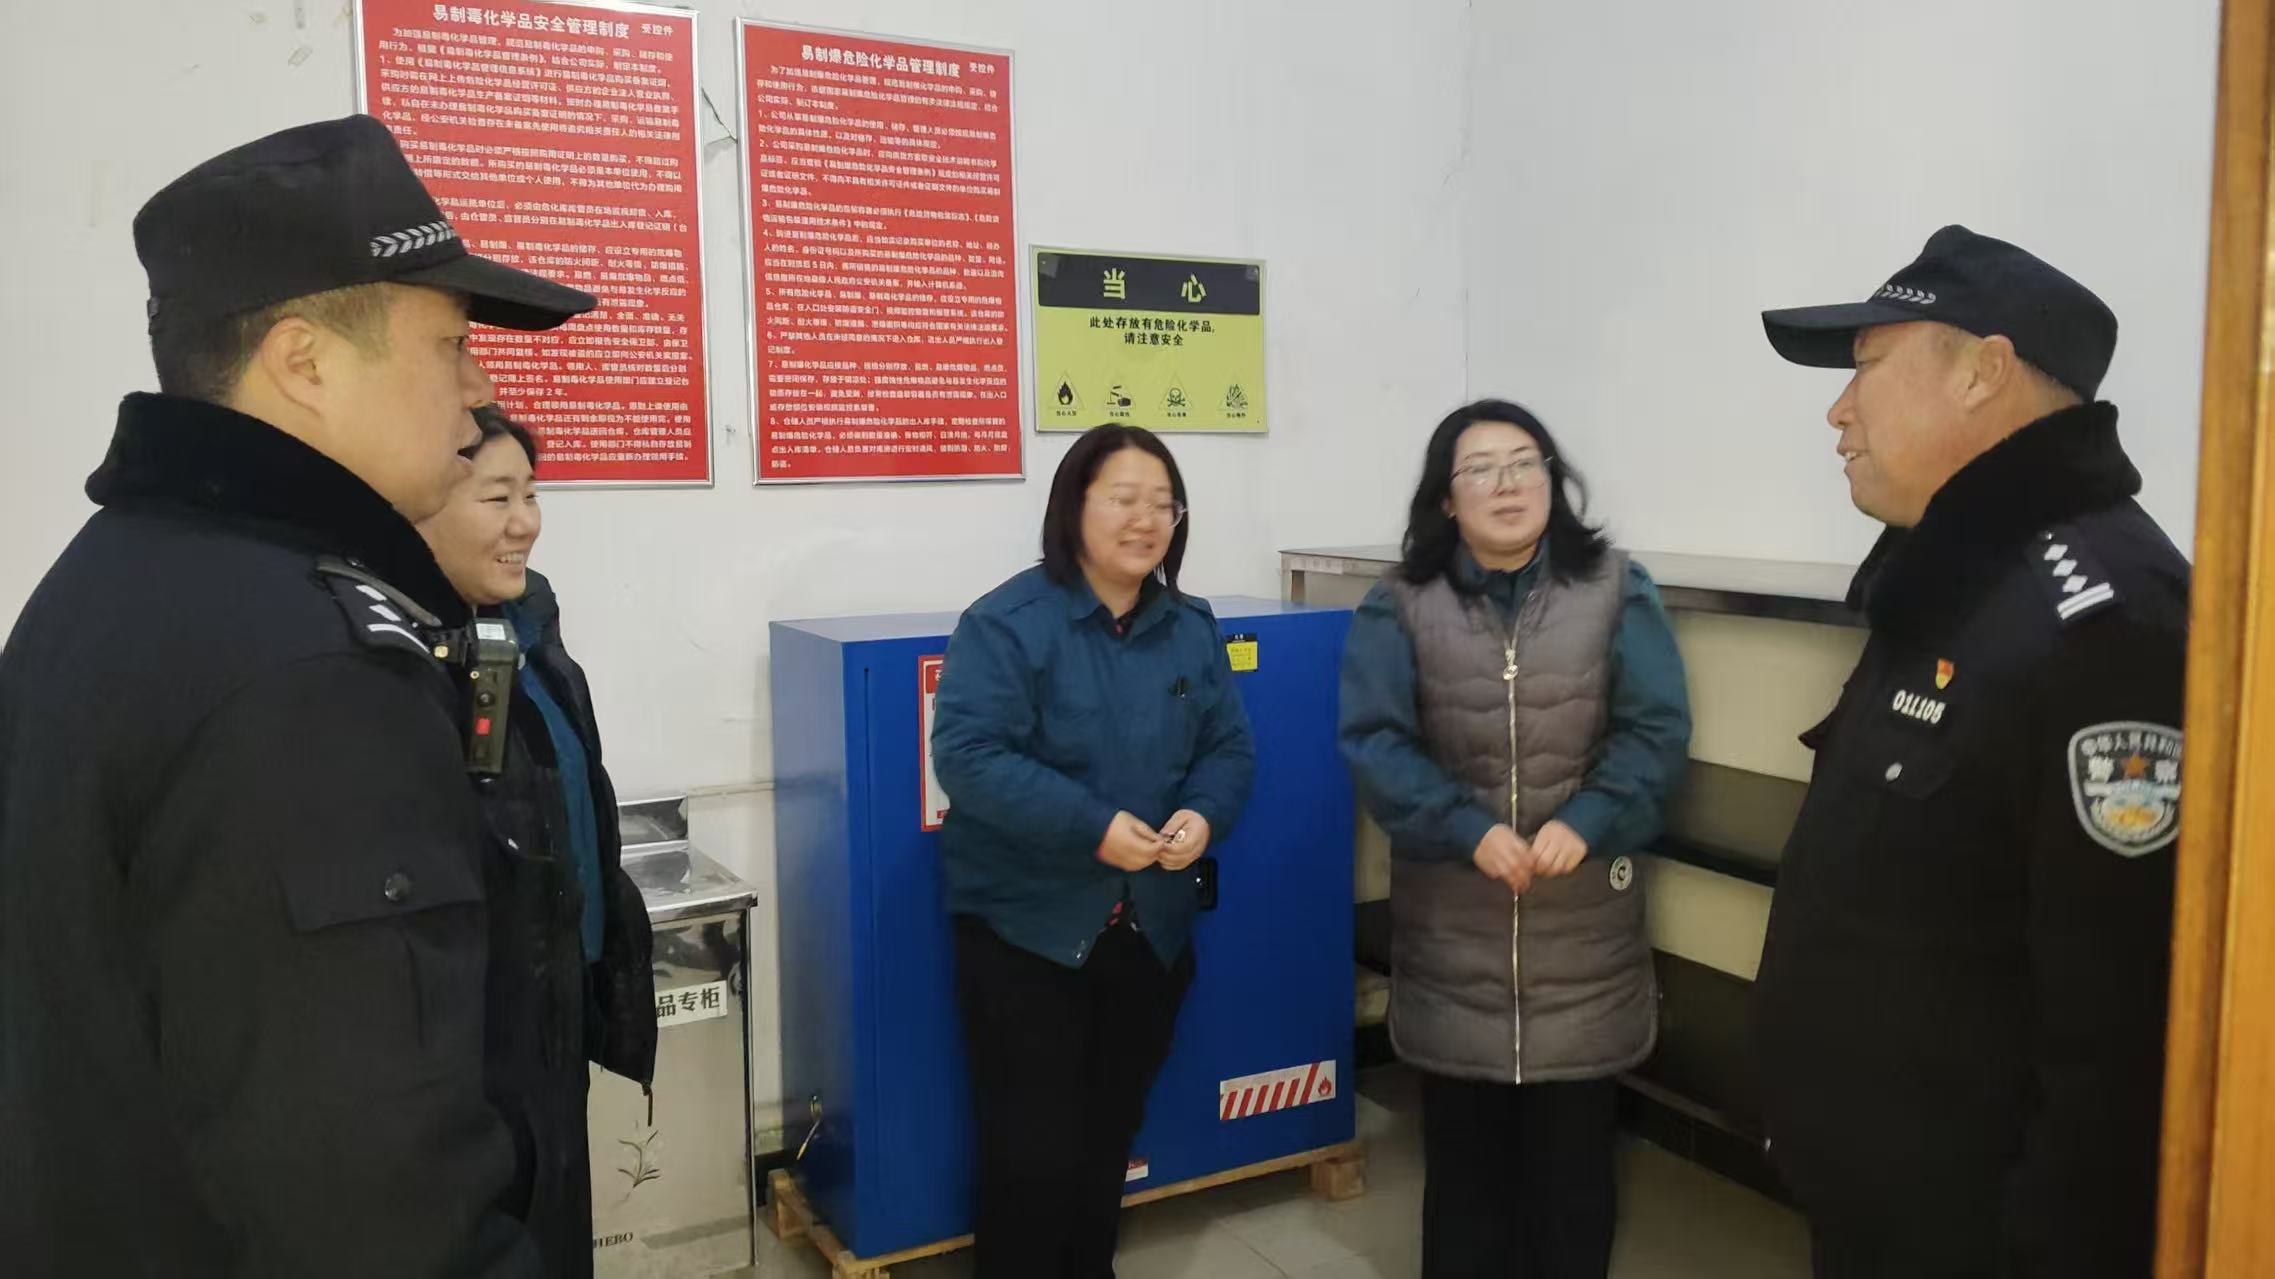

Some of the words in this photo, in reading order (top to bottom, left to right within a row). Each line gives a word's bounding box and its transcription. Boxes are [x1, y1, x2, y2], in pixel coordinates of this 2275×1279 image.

[432, 3, 629, 39] 易制毒化学品安全管理制度
[801, 44, 959, 78] 易制爆危险化学品管理制度
[1103, 267, 1126, 300] 当
[1180, 273, 1207, 303] 心
[1123, 332, 1184, 347] 请注意安全
[1892, 689, 1946, 725] 011105
[657, 986, 720, 1018] 品专柜
